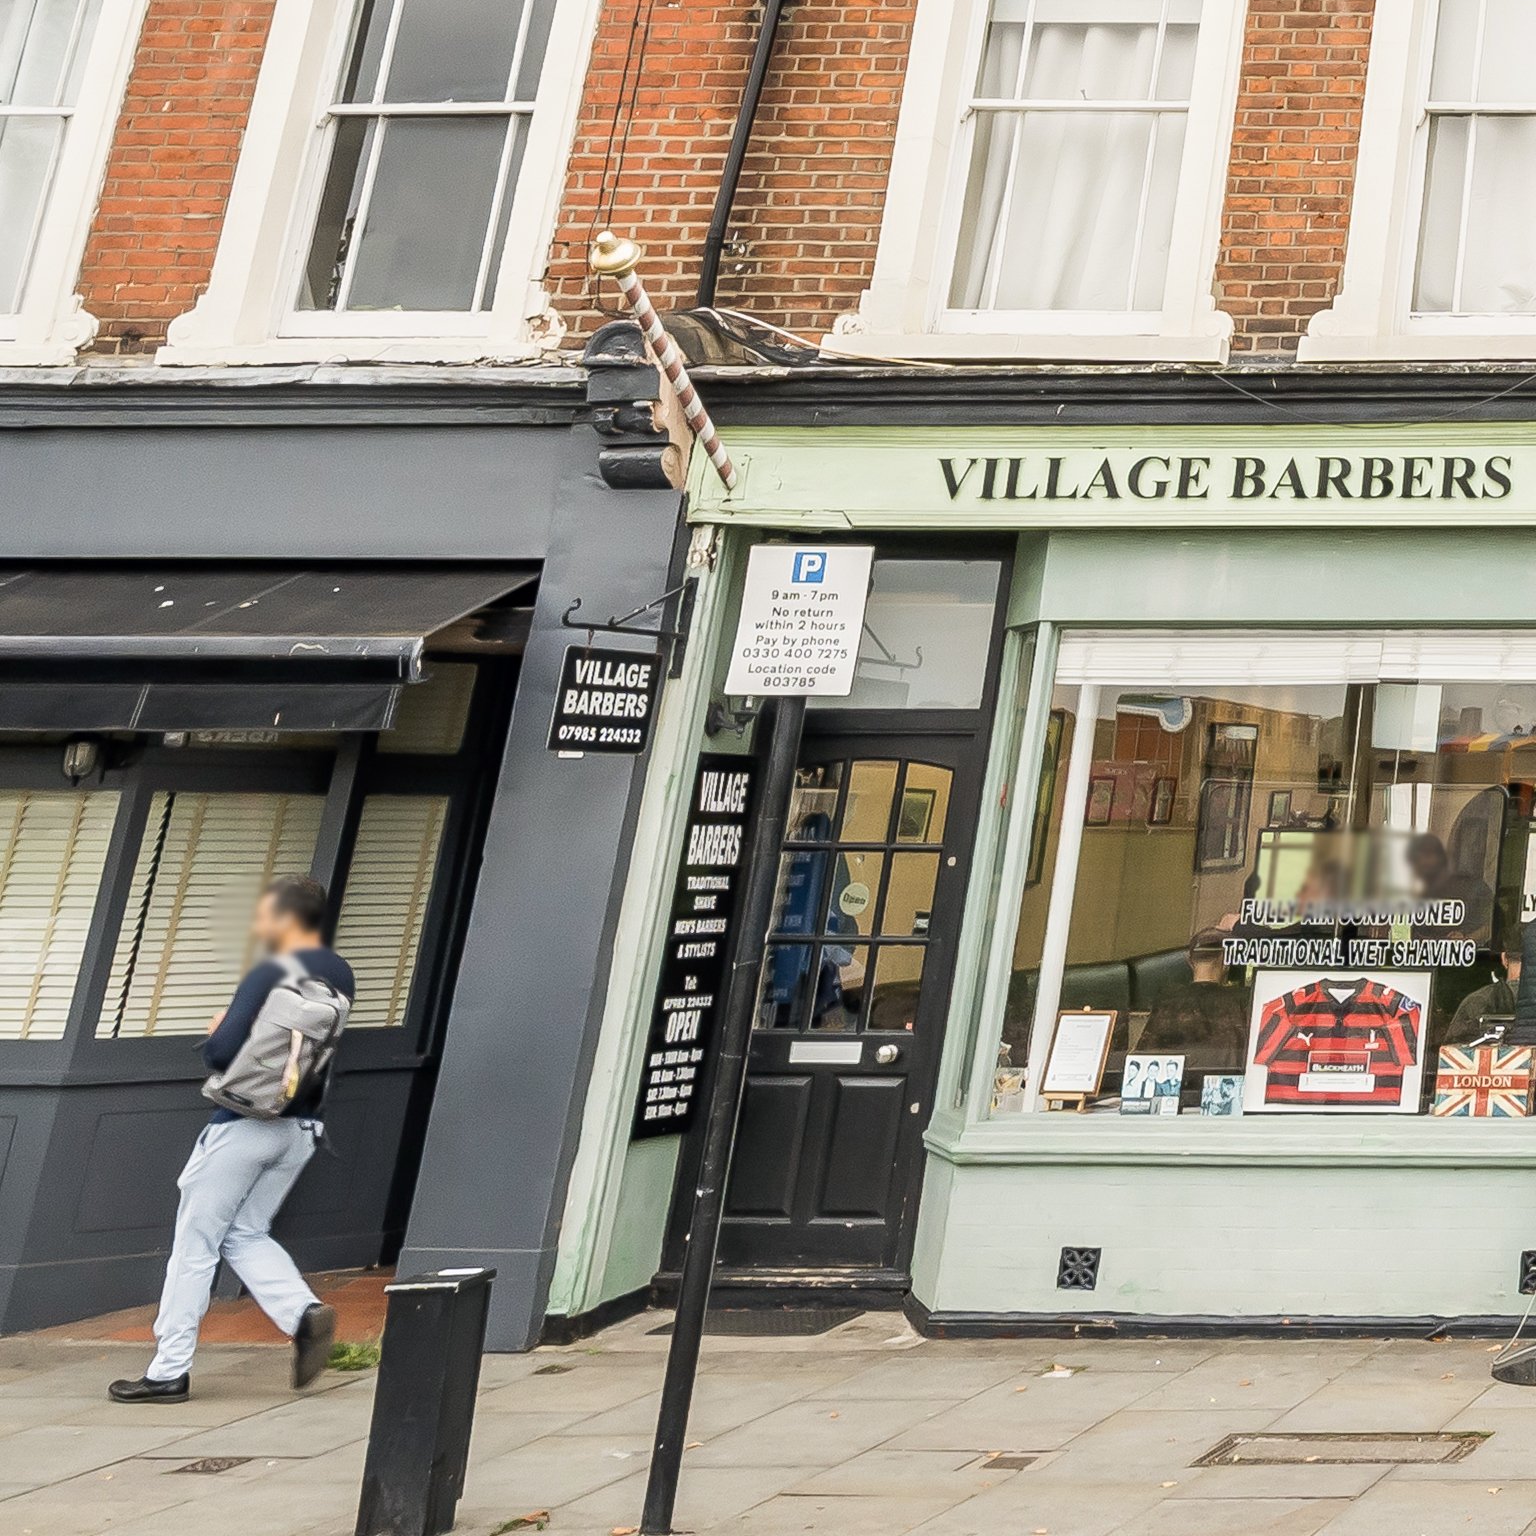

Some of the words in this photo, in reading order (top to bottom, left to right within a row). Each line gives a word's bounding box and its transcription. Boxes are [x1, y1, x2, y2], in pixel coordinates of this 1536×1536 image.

[937, 456, 1210, 500] VILLAGE
[1228, 456, 1512, 500] BARBERS
[799, 554, 822, 581] P
[772, 607, 789, 617] No
[794, 608, 833, 617] return
[755, 620, 793, 630] within
[798, 621, 805, 630] 2
[811, 621, 845, 630] hours
[756, 635, 777, 647] Pay
[783, 636, 797, 647] by
[801, 636, 839, 647] phone
[742, 648, 779, 658] 0330
[784, 649, 812, 659] 400
[818, 649, 848, 659] 7275
[576, 659, 651, 688] VILLAGE
[748, 663, 801, 674] Location
[807, 664, 836, 674] code
[763, 677, 816, 687] 803785
[563, 689, 648, 718] BARBERS
[558, 725, 597, 741] 07985
[599, 727, 641, 743] 224332
[699, 771, 749, 813] VILLAGE
[687, 824, 742, 865] BARBERS
[687, 876, 729, 890] TRADITIONAL
[843, 892, 866, 905] Open
[1241, 899, 1299, 925] FULLY
[696, 918, 727, 933] BARBERS
[684, 942, 716, 958] STYLISTS
[1223, 939, 1344, 966] TRADITIONAL
[1350, 940, 1389, 966] WET
[1392, 940, 1476, 967] SHAVING
[665, 1010, 701, 1043] OPEN
[1453, 1075, 1512, 1089] LONDON
